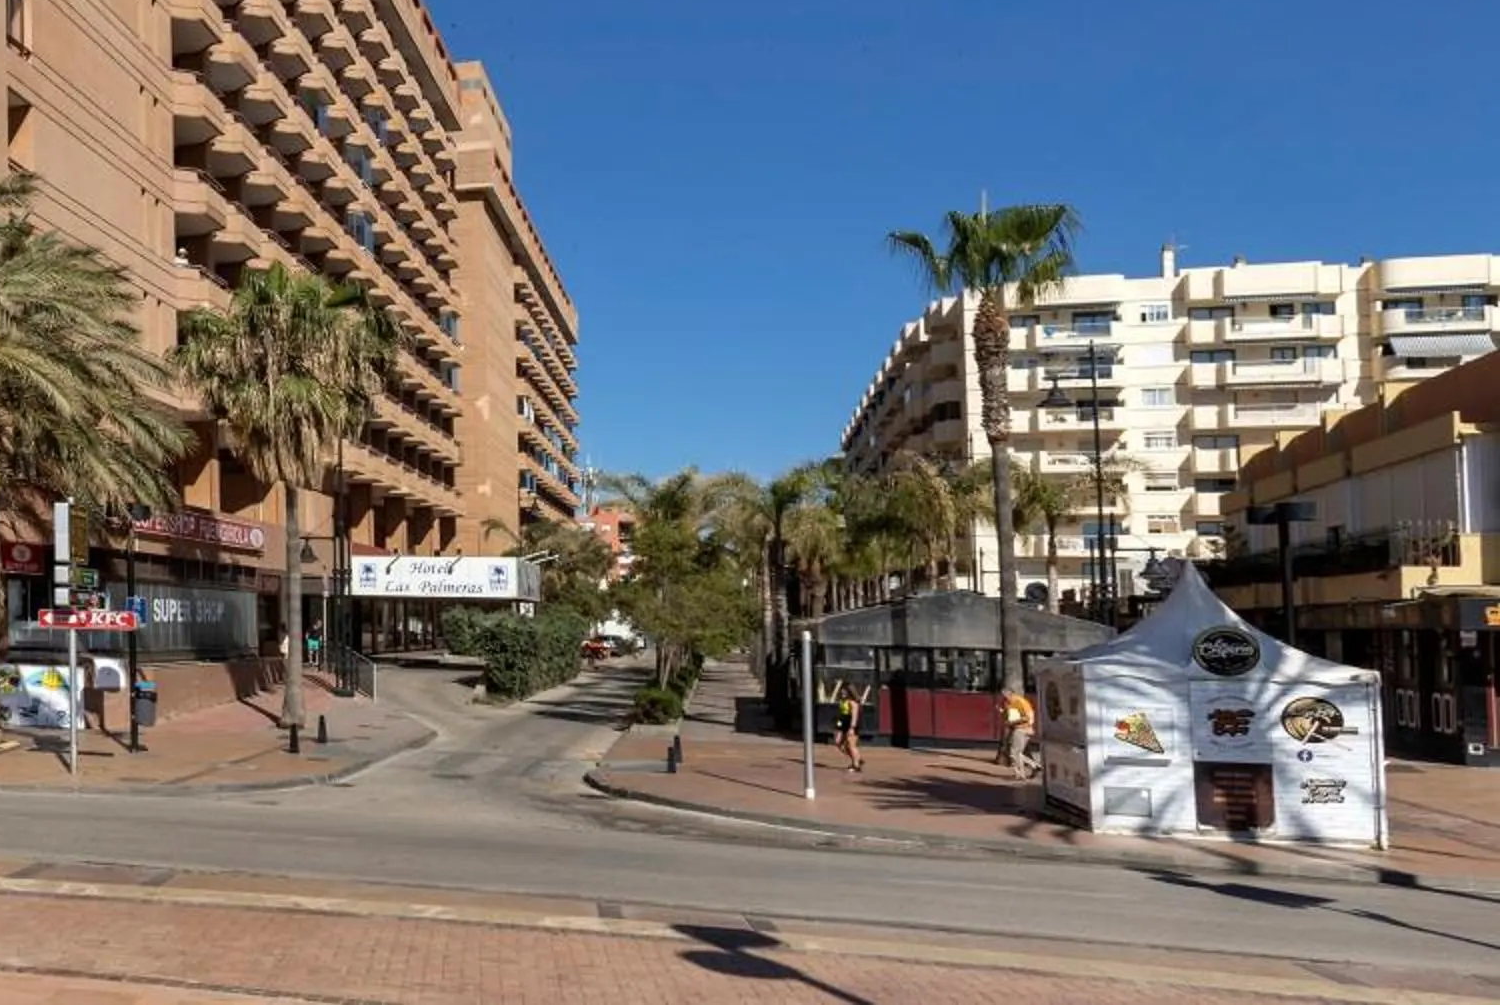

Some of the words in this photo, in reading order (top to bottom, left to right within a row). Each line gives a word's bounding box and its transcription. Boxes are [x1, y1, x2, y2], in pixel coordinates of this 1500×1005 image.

[410, 561, 454, 575] Hotel
[385, 581, 410, 593] Las
[418, 580, 484, 594] Palmeras
[153, 598, 193, 623] SUPER
[90, 611, 129, 626] KFC
